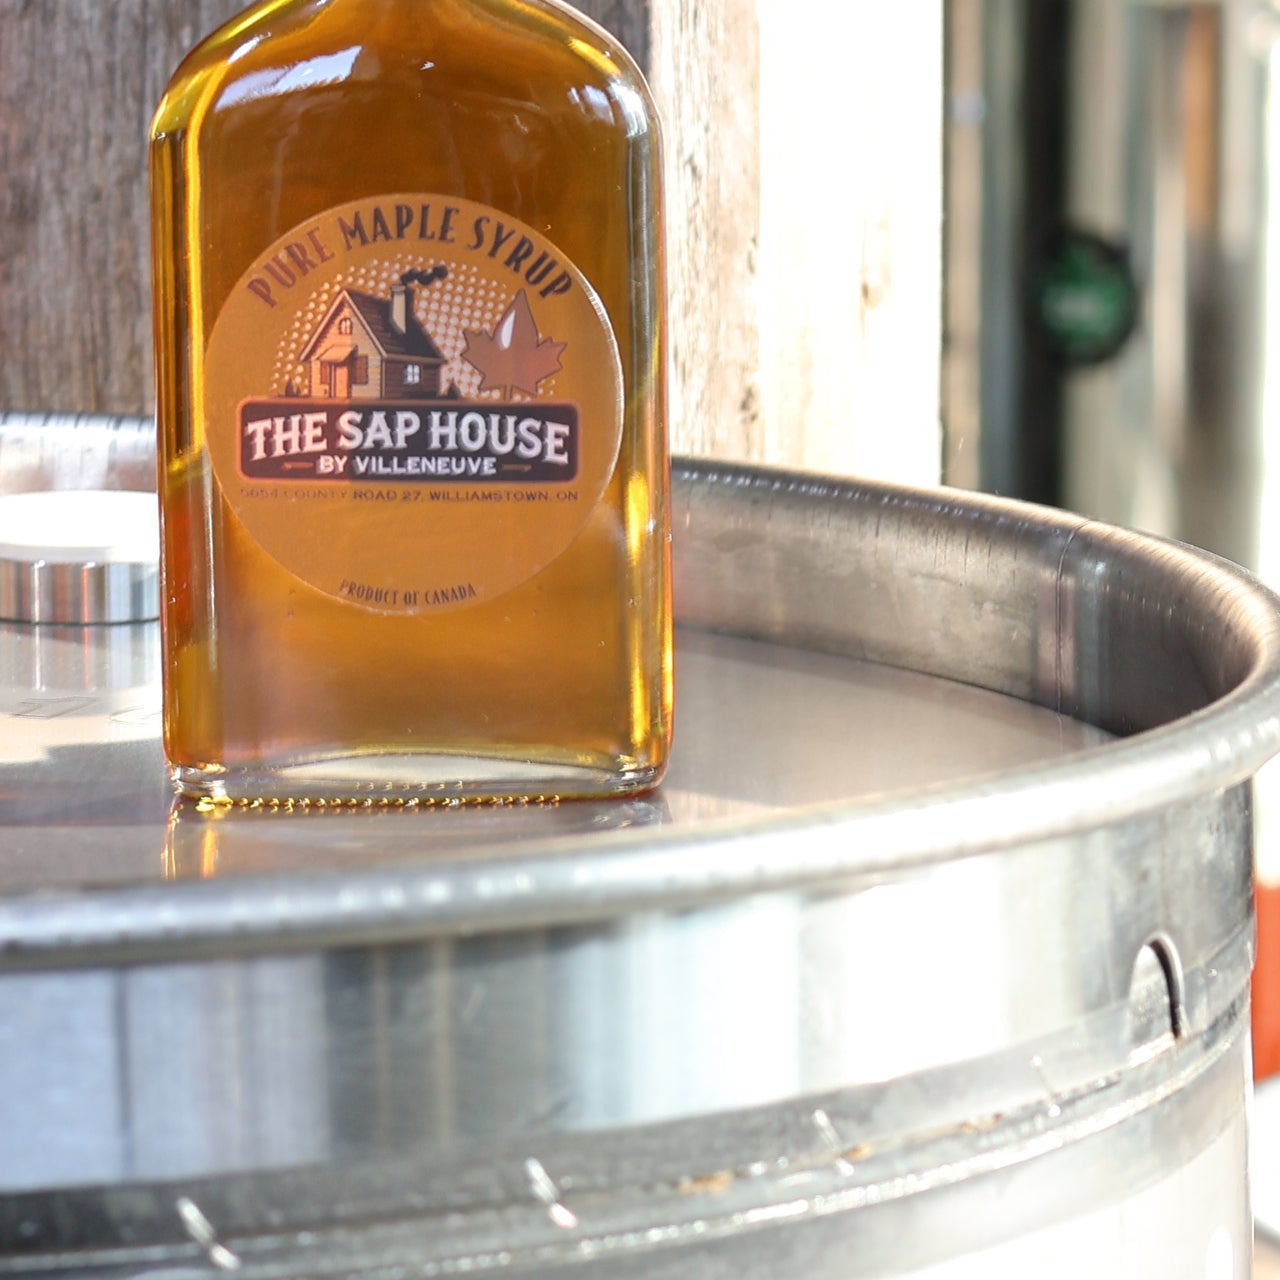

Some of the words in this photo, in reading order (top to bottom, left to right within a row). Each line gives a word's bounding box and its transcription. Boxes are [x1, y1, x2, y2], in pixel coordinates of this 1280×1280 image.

[247, 226, 336, 308] PURE
[339, 204, 460, 251] MAPLE
[467, 216, 573, 299] SYRUP
[246, 412, 328, 462] THE
[339, 411, 420, 450] SAP
[428, 411, 570, 465] HOUSE
[317, 456, 348, 475] BY
[355, 456, 496, 475] VILLENEUVE
[284, 488, 347, 500] COUNTY
[353, 488, 397, 501] ROAD
[556, 489, 579, 501] ON
[339, 579, 399, 605] PRODUCT
[403, 590, 419, 606] OF
[424, 582, 477, 605] CANADA
